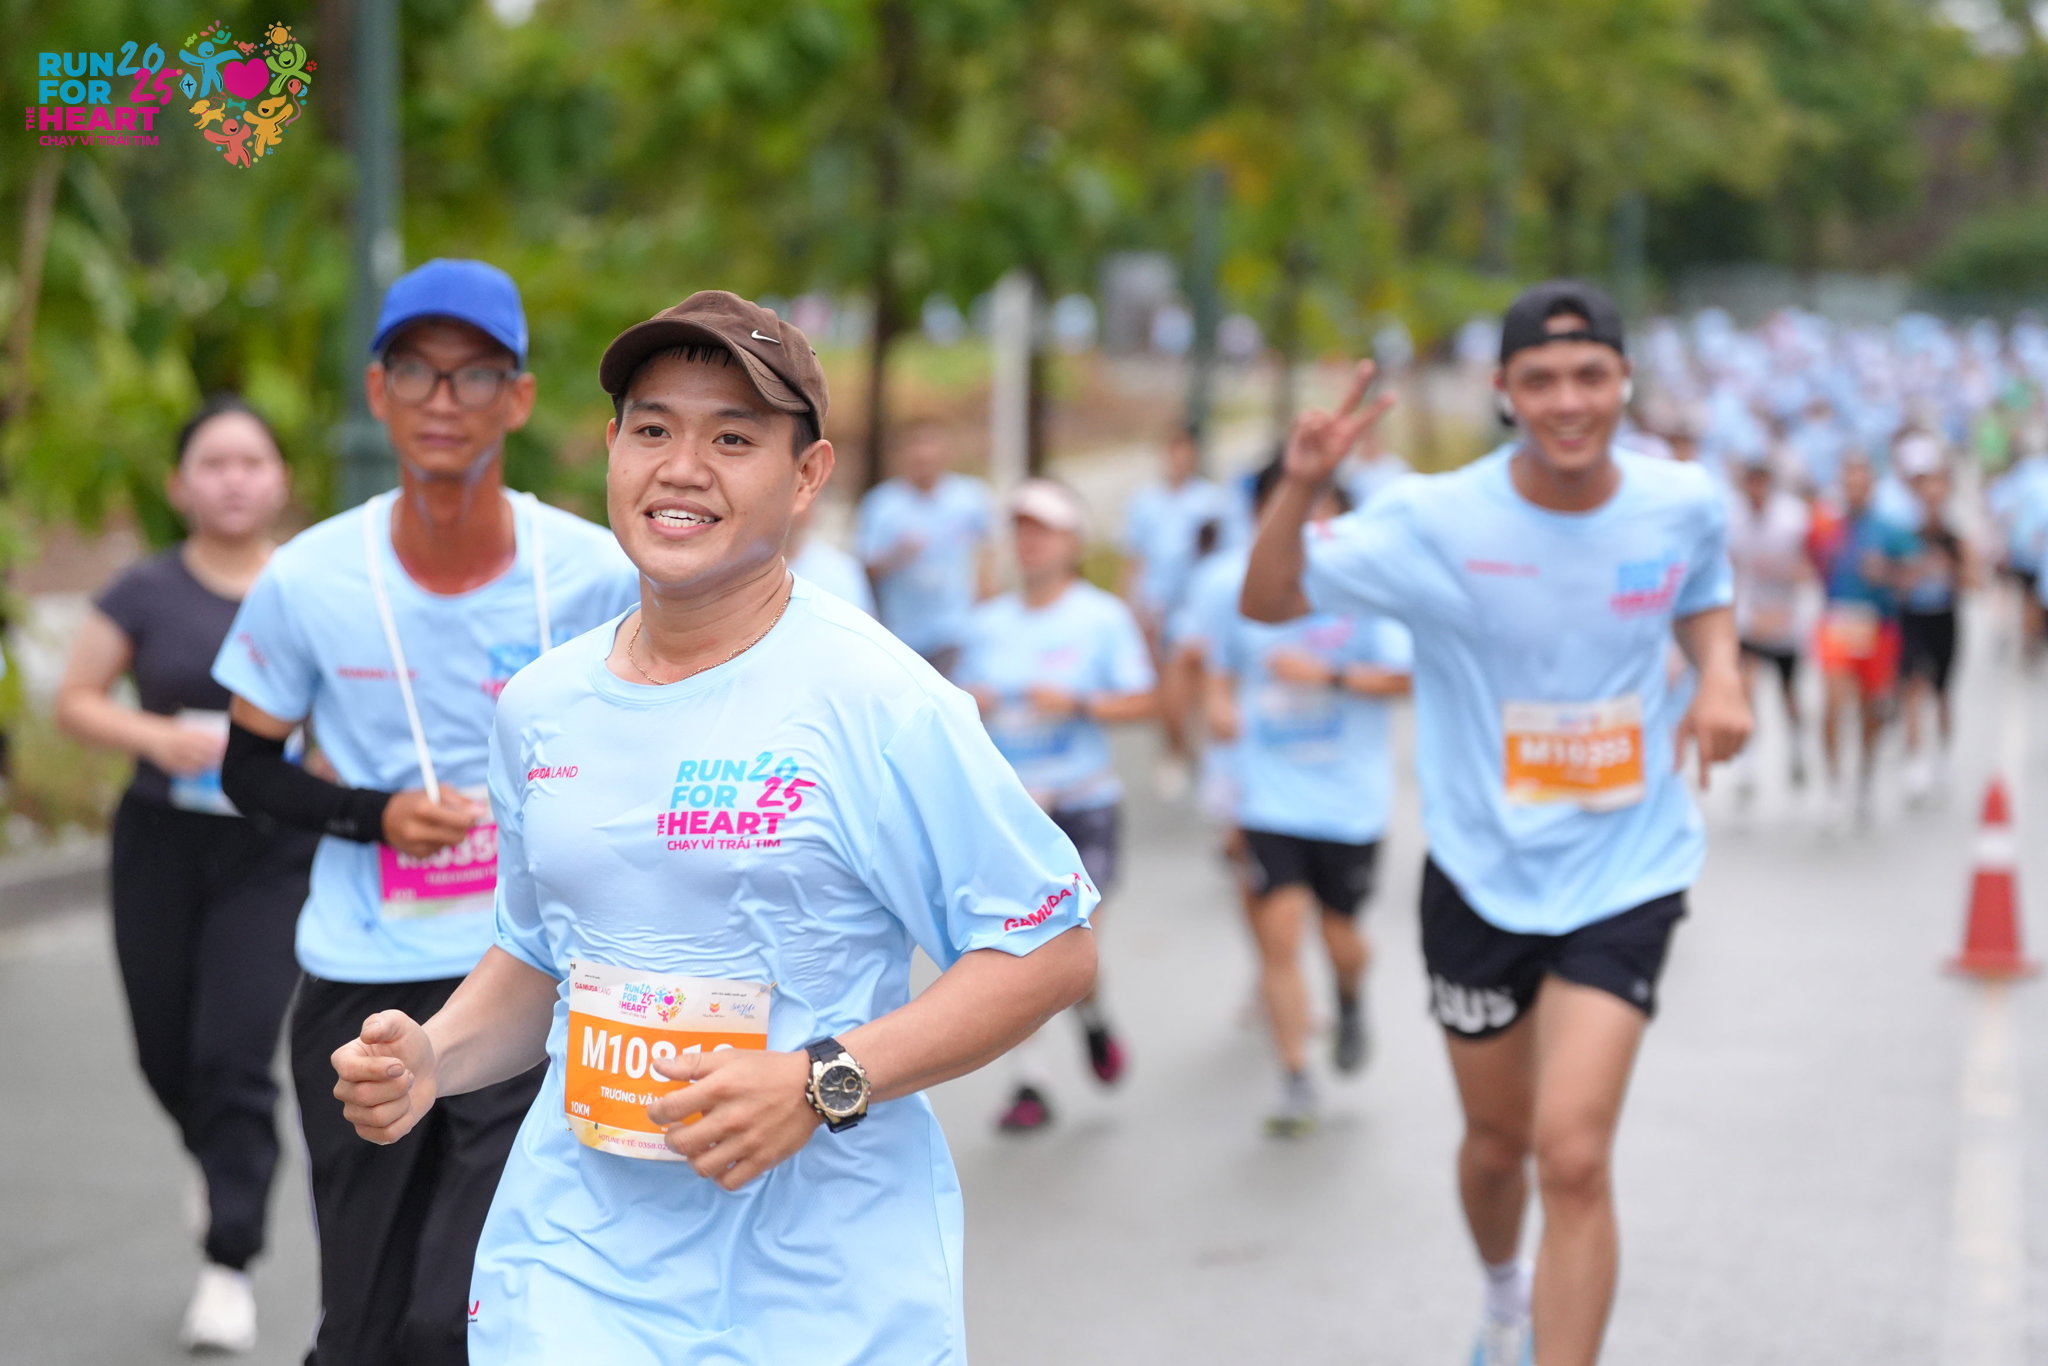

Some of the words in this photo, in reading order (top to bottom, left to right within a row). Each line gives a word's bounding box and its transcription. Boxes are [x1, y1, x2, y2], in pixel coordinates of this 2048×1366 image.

[551, 766, 579, 778] LAND
[676, 760, 747, 783] RUN
[748, 751, 799, 782] 20
[670, 785, 738, 809] FOR
[756, 776, 817, 812] 25
[657, 813, 665, 836] THE
[667, 811, 786, 836] HEART
[667, 839, 699, 852] CHẠY
[702, 837, 715, 849] VÌ
[717, 836, 750, 850] TRÁI
[753, 839, 782, 848] TIM
[1004, 888, 1072, 931] GAMUDA
[624, 983, 639, 994] RUN
[622, 992, 637, 1002] FOR
[621, 1001, 648, 1014] HEART
[571, 1101, 590, 1117] 10KM
[598, 1134, 620, 1144] HOTLINE
